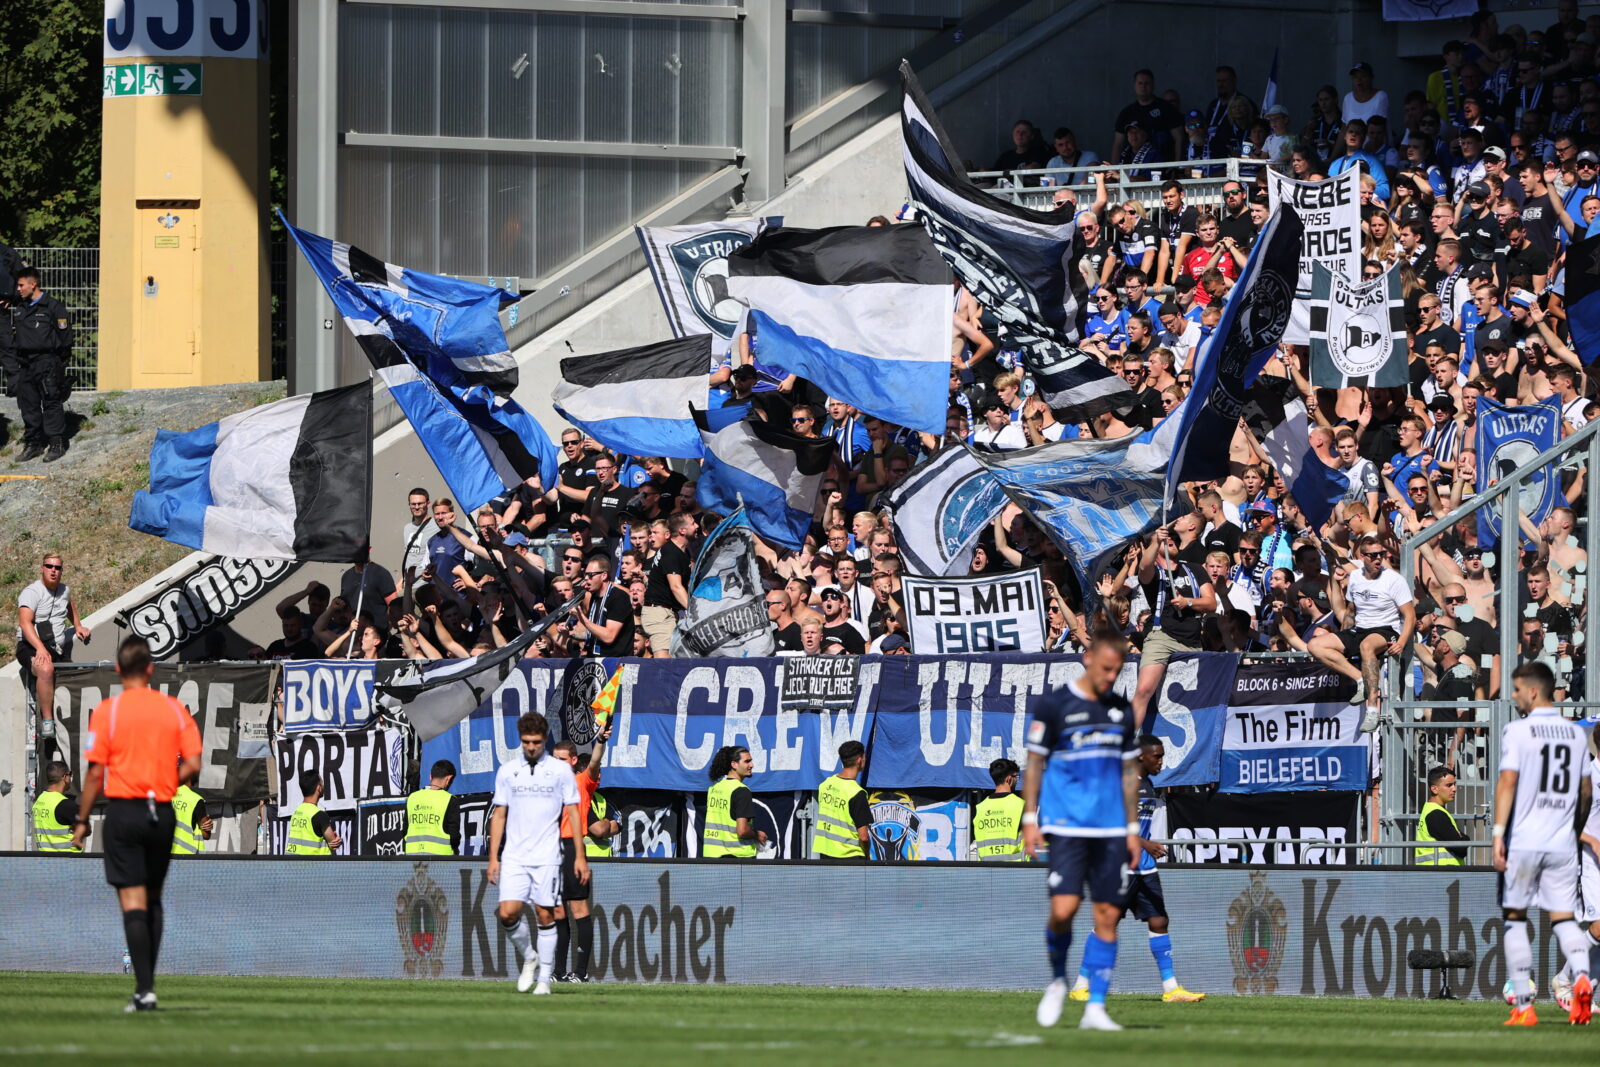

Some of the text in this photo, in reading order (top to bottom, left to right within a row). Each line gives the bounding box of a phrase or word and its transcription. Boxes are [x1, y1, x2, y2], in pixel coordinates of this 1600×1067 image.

[682, 239, 744, 259] UTRA
[1492, 413, 1547, 438] ULTRAS
[914, 580, 1034, 616] 03.MAI
[936, 618, 1021, 653] 1905
[573, 664, 605, 686] SEKTION
[833, 658, 854, 675] ALS
[809, 677, 854, 695] AUFLAGE
[1236, 674, 1340, 692] BLOCK 6 SINCE 1998
[286, 668, 374, 728] BOYS
[1235, 710, 1340, 744] The Firm
[1530, 725, 1576, 740] BIELEFELD
[279, 730, 391, 808] PORTA
[1239, 756, 1342, 784] BIELEFELD
[1539, 743, 1571, 794] 13
[511, 783, 554, 793] SCHÜCO
[979, 816, 1013, 830] ORDNER
[988, 846, 1005, 855] 157
[458, 868, 736, 984] Kbacher
